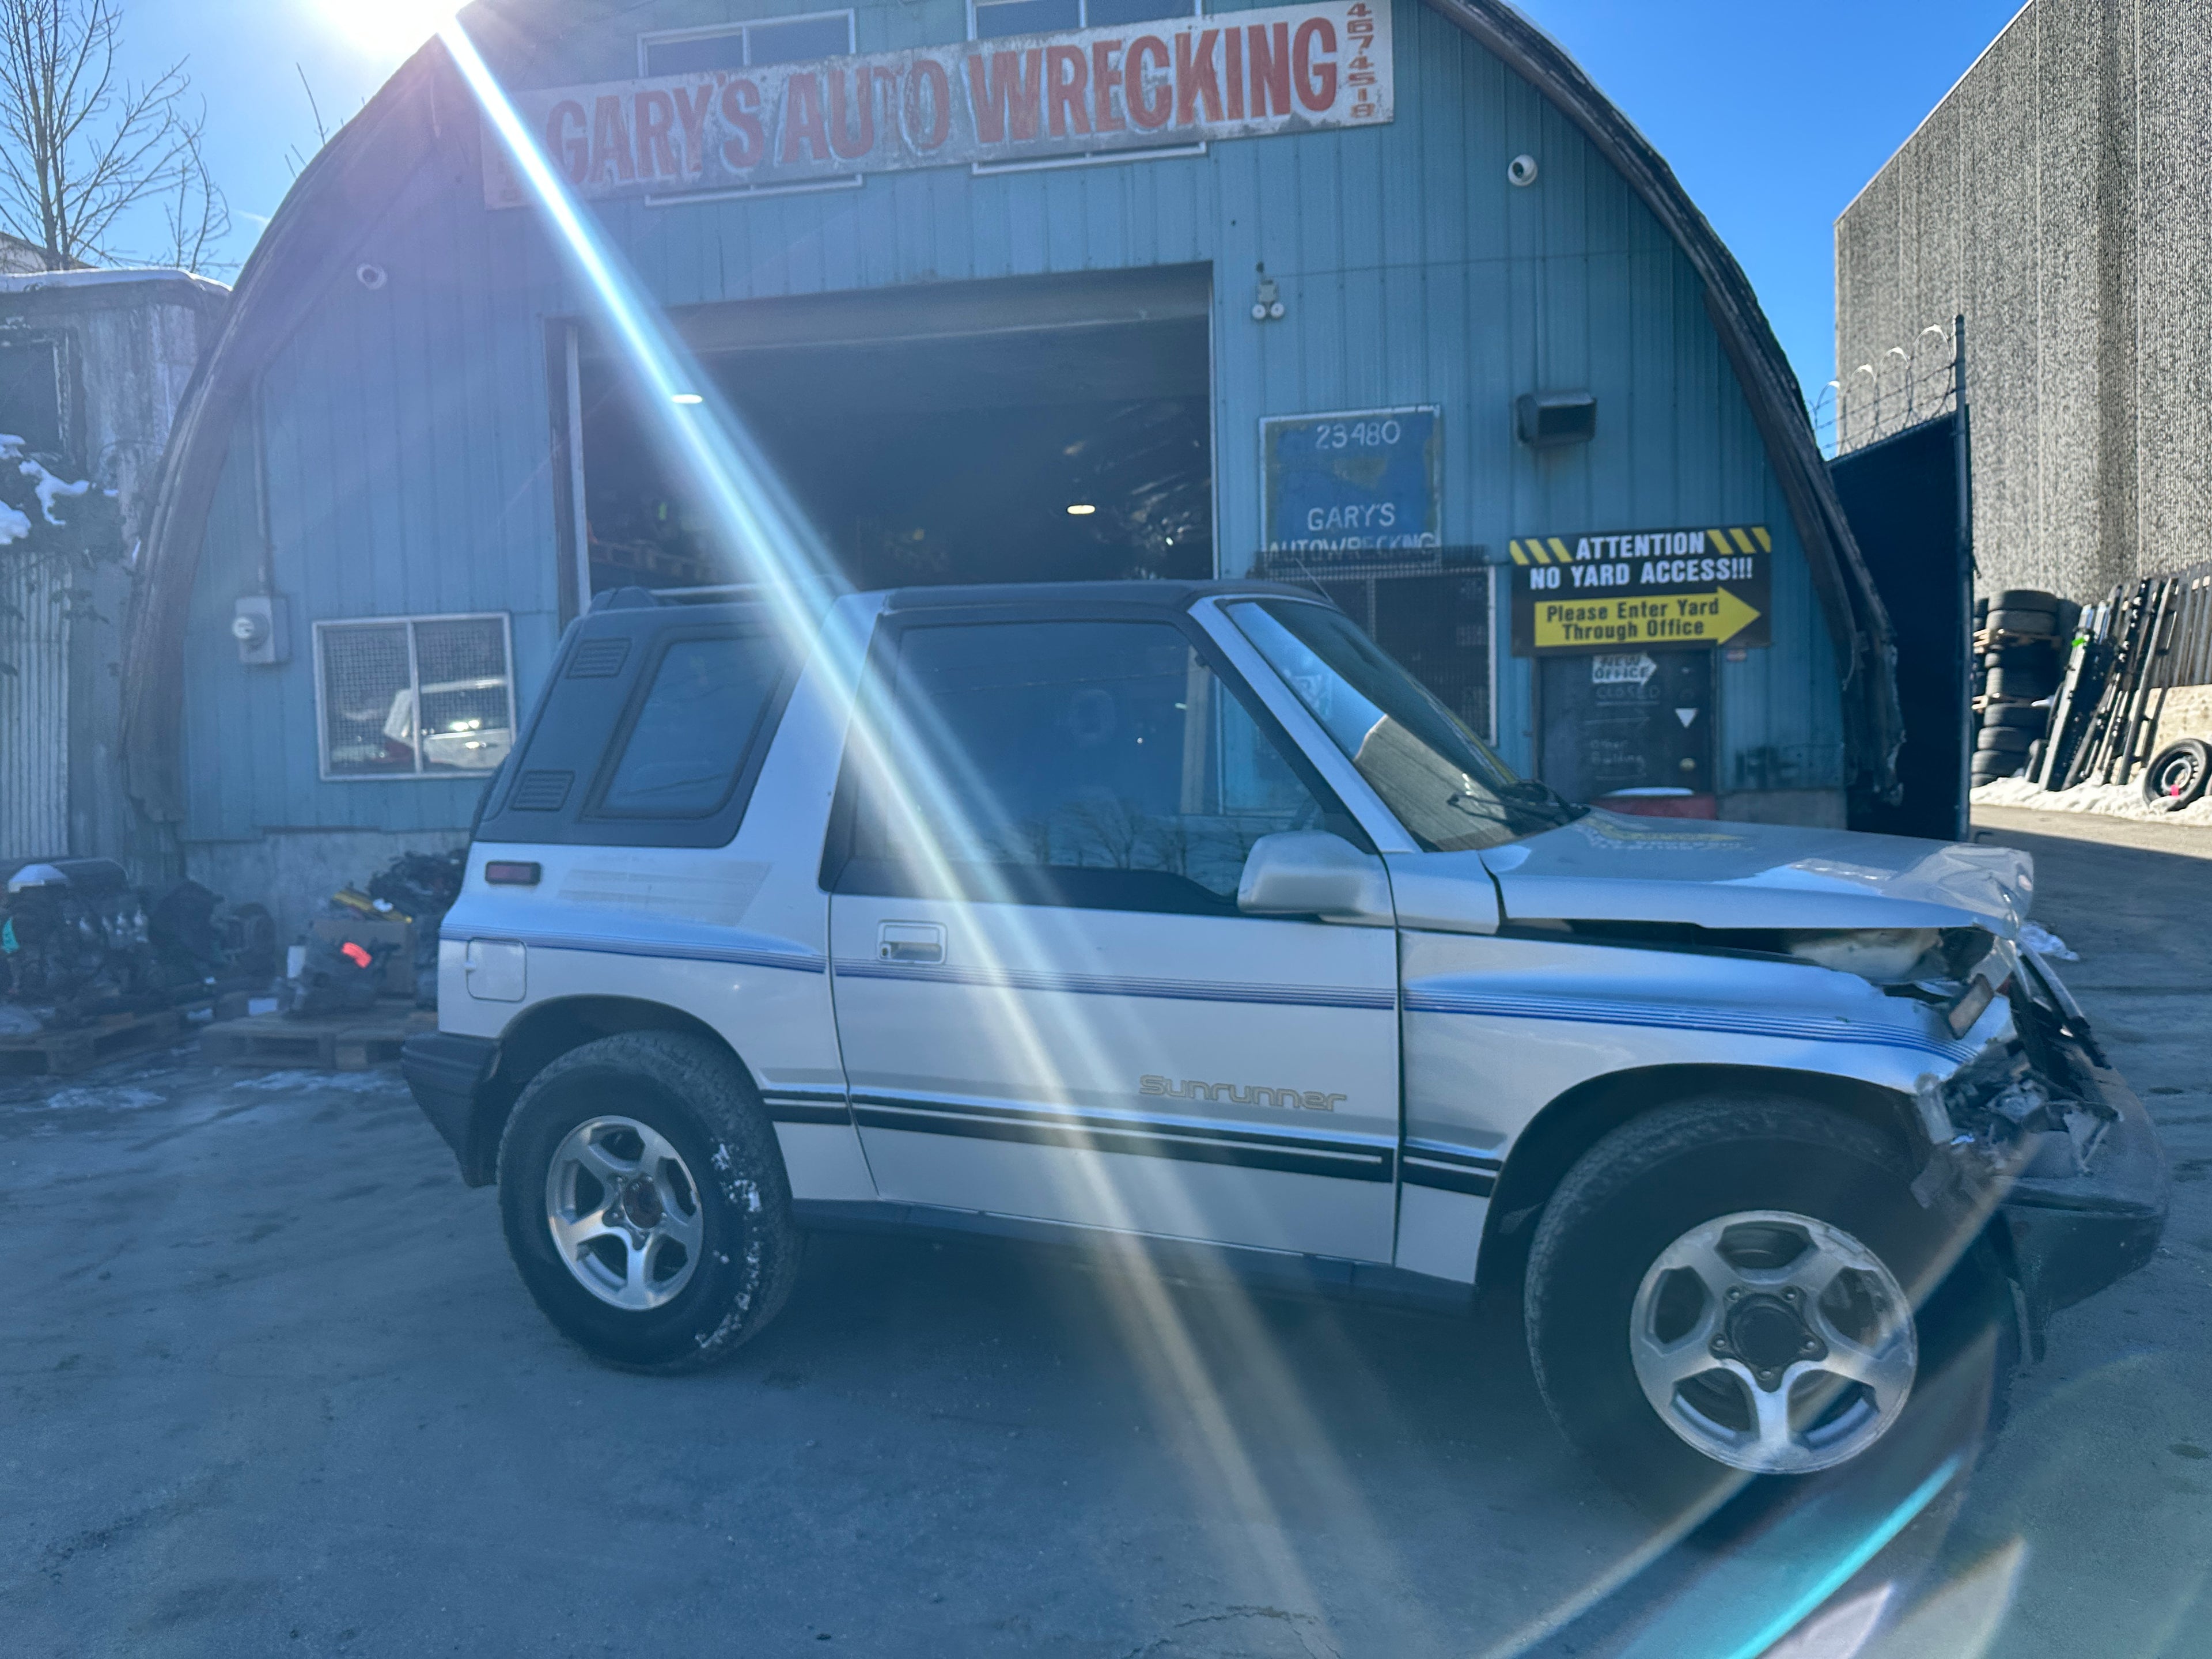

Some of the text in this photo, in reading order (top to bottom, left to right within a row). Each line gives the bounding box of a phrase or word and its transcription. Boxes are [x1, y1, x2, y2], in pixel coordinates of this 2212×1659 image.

[547, 73, 764, 184] GARY'S
[783, 59, 950, 164] AUTO
[969, 17, 1338, 143] WRECKING
[1316, 420, 1401, 449] 23480
[1307, 502, 1396, 531] GARY'S
[1575, 531, 1705, 560] ATTENTION
[1530, 557, 1753, 590] NO YARD ACCESS!!!
[1547, 597, 1719, 623] Please Enter Yard
[1562, 618, 1704, 641] Through Office
[1594, 666, 1649, 679] OFFICE
[1139, 1074, 1347, 1112] Sunrunner
